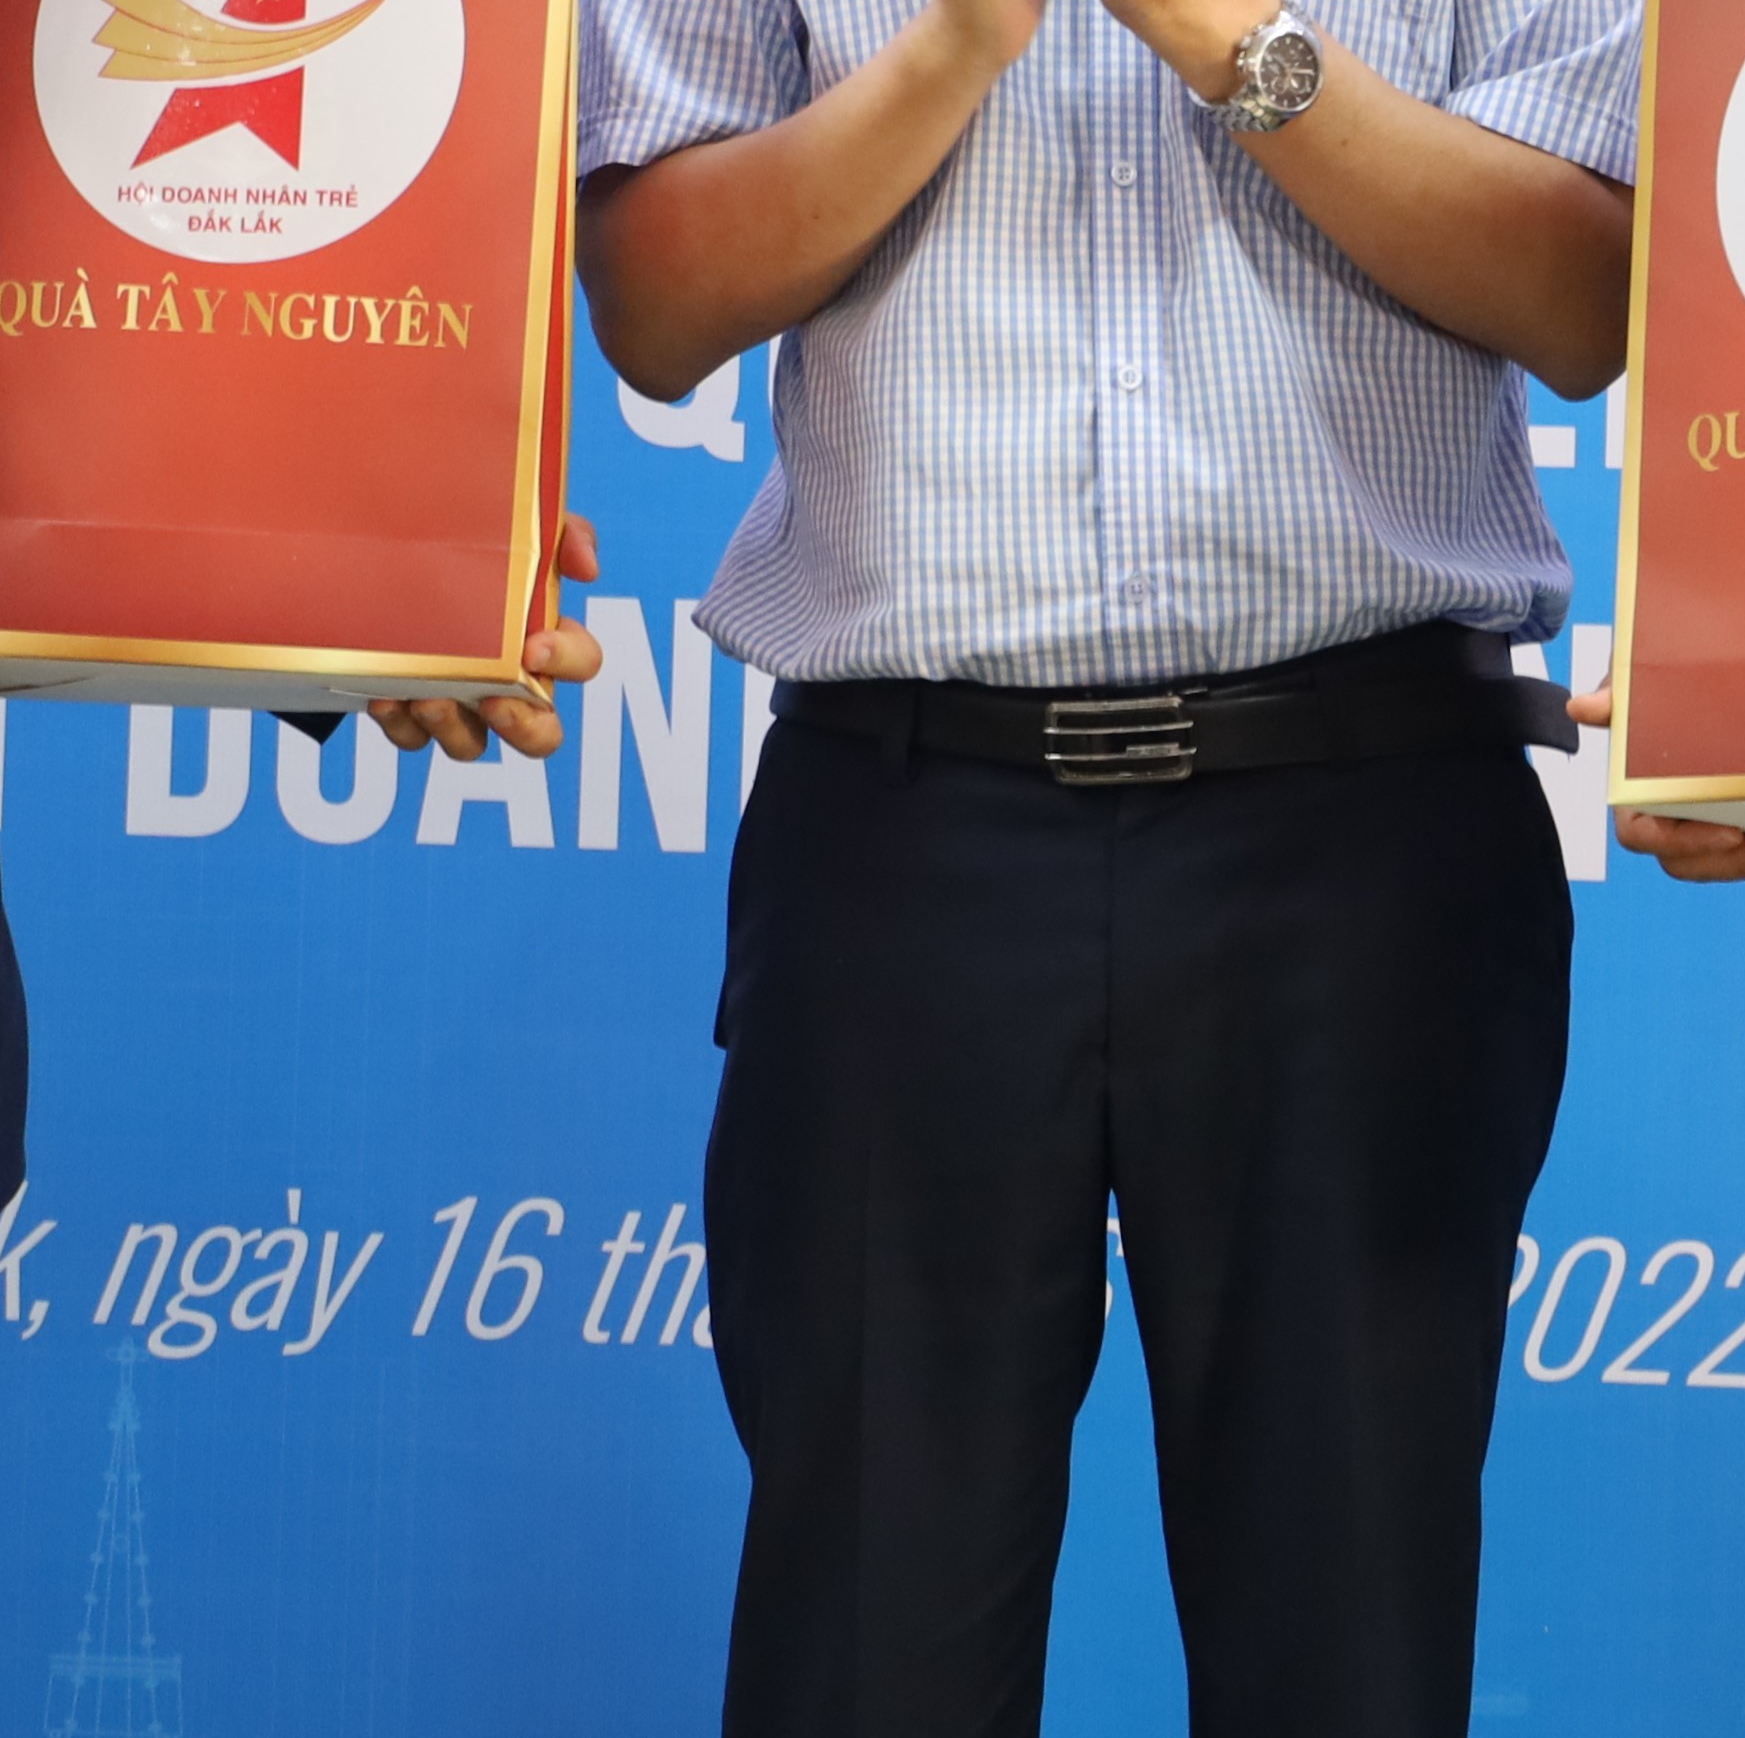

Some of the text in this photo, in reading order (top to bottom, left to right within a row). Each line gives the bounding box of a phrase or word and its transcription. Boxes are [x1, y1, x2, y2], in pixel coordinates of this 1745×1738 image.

[117, 181, 359, 208] HỘI DOANH NHÂN TRẺ
[187, 209, 283, 234] ĐẮK LẮK
[116, 271, 228, 334] TÂY
[240, 285, 474, 350] NGUYÊN
[92, 1188, 384, 1359] ngày
[411, 1195, 565, 1341] 16
